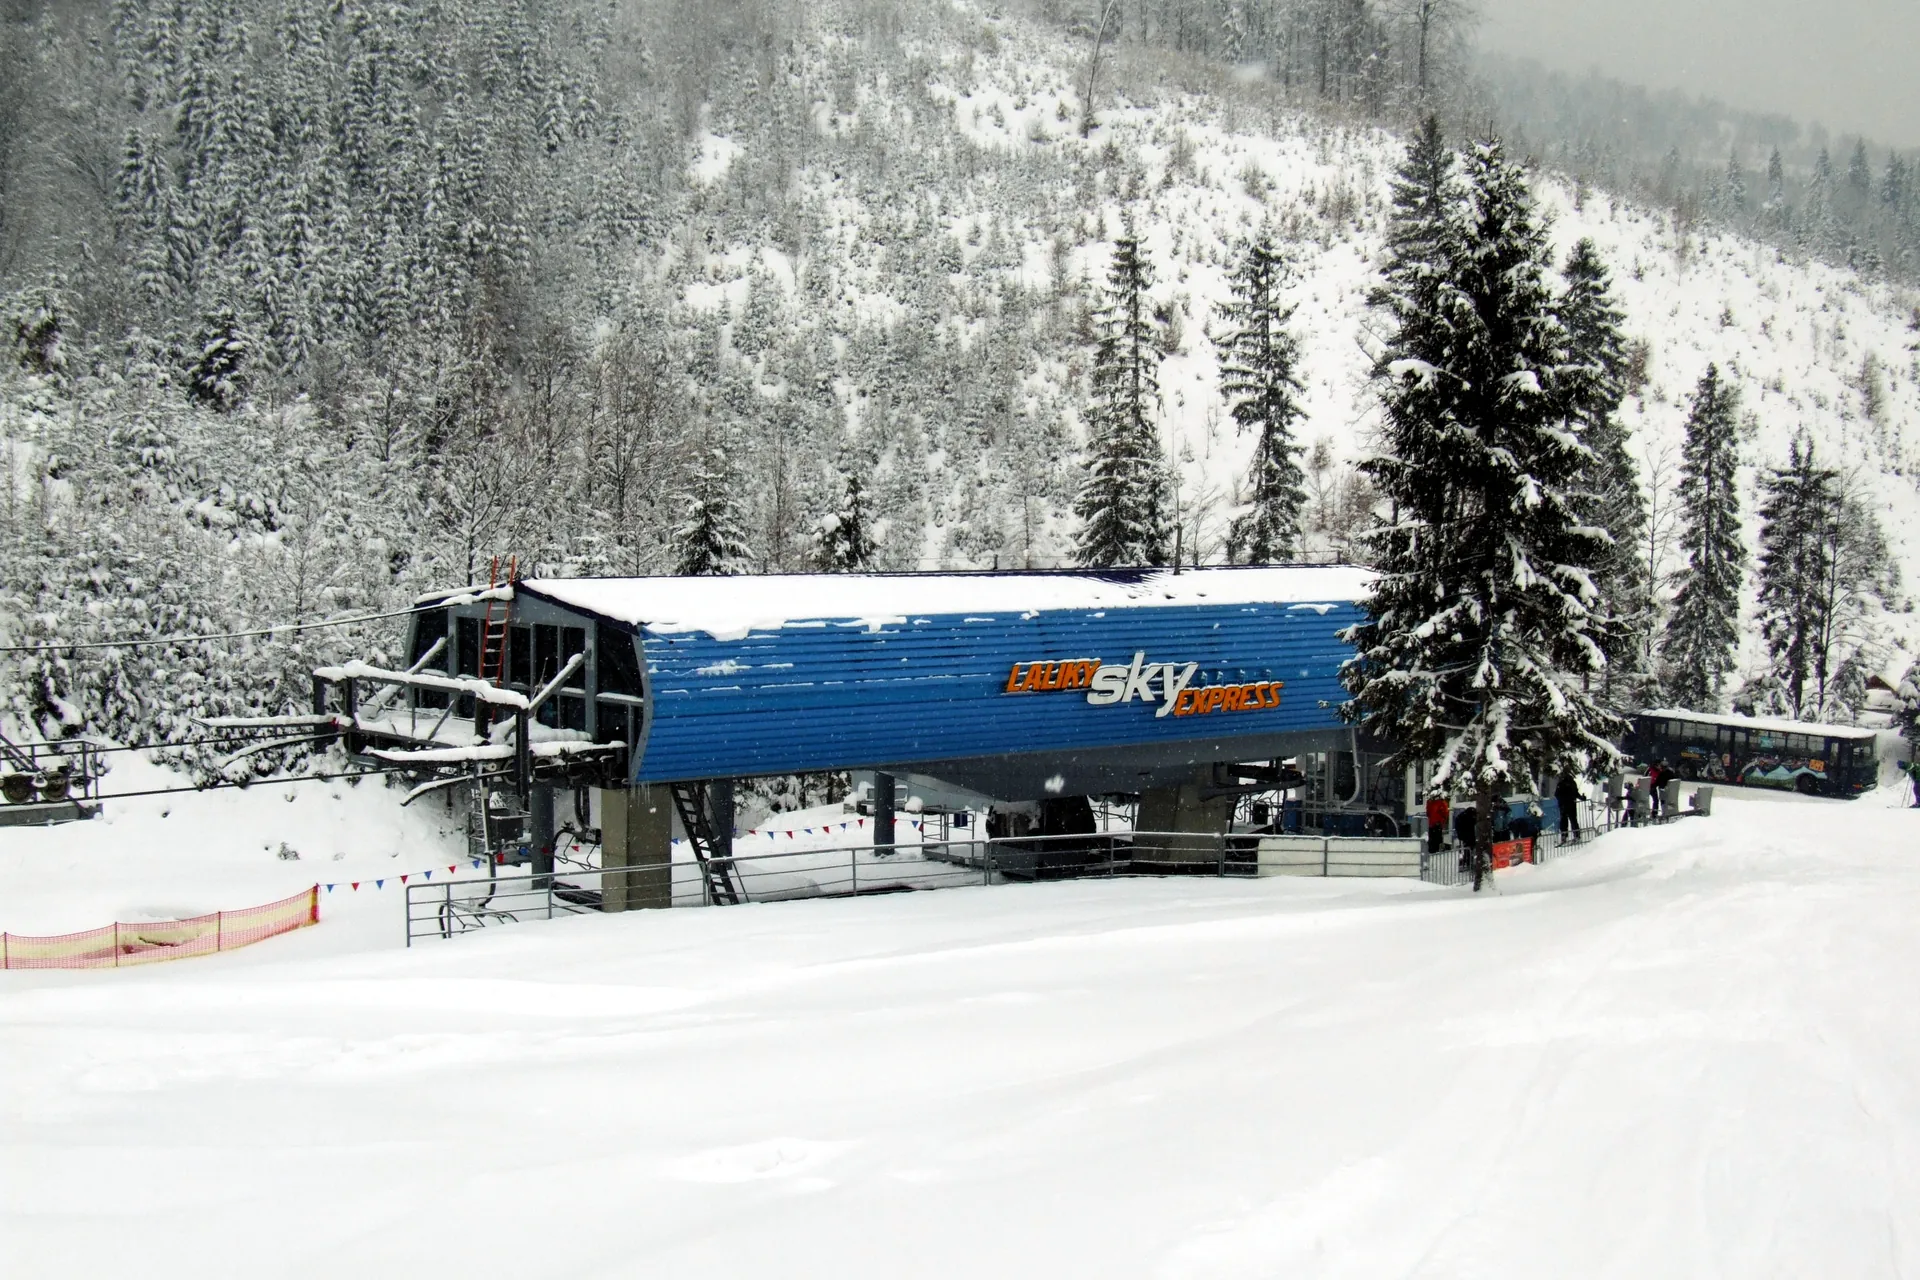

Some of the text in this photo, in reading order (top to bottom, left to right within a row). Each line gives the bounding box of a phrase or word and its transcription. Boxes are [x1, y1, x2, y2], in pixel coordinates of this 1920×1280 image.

[1007, 652, 1284, 718] LALIKY sky EXPRESS
